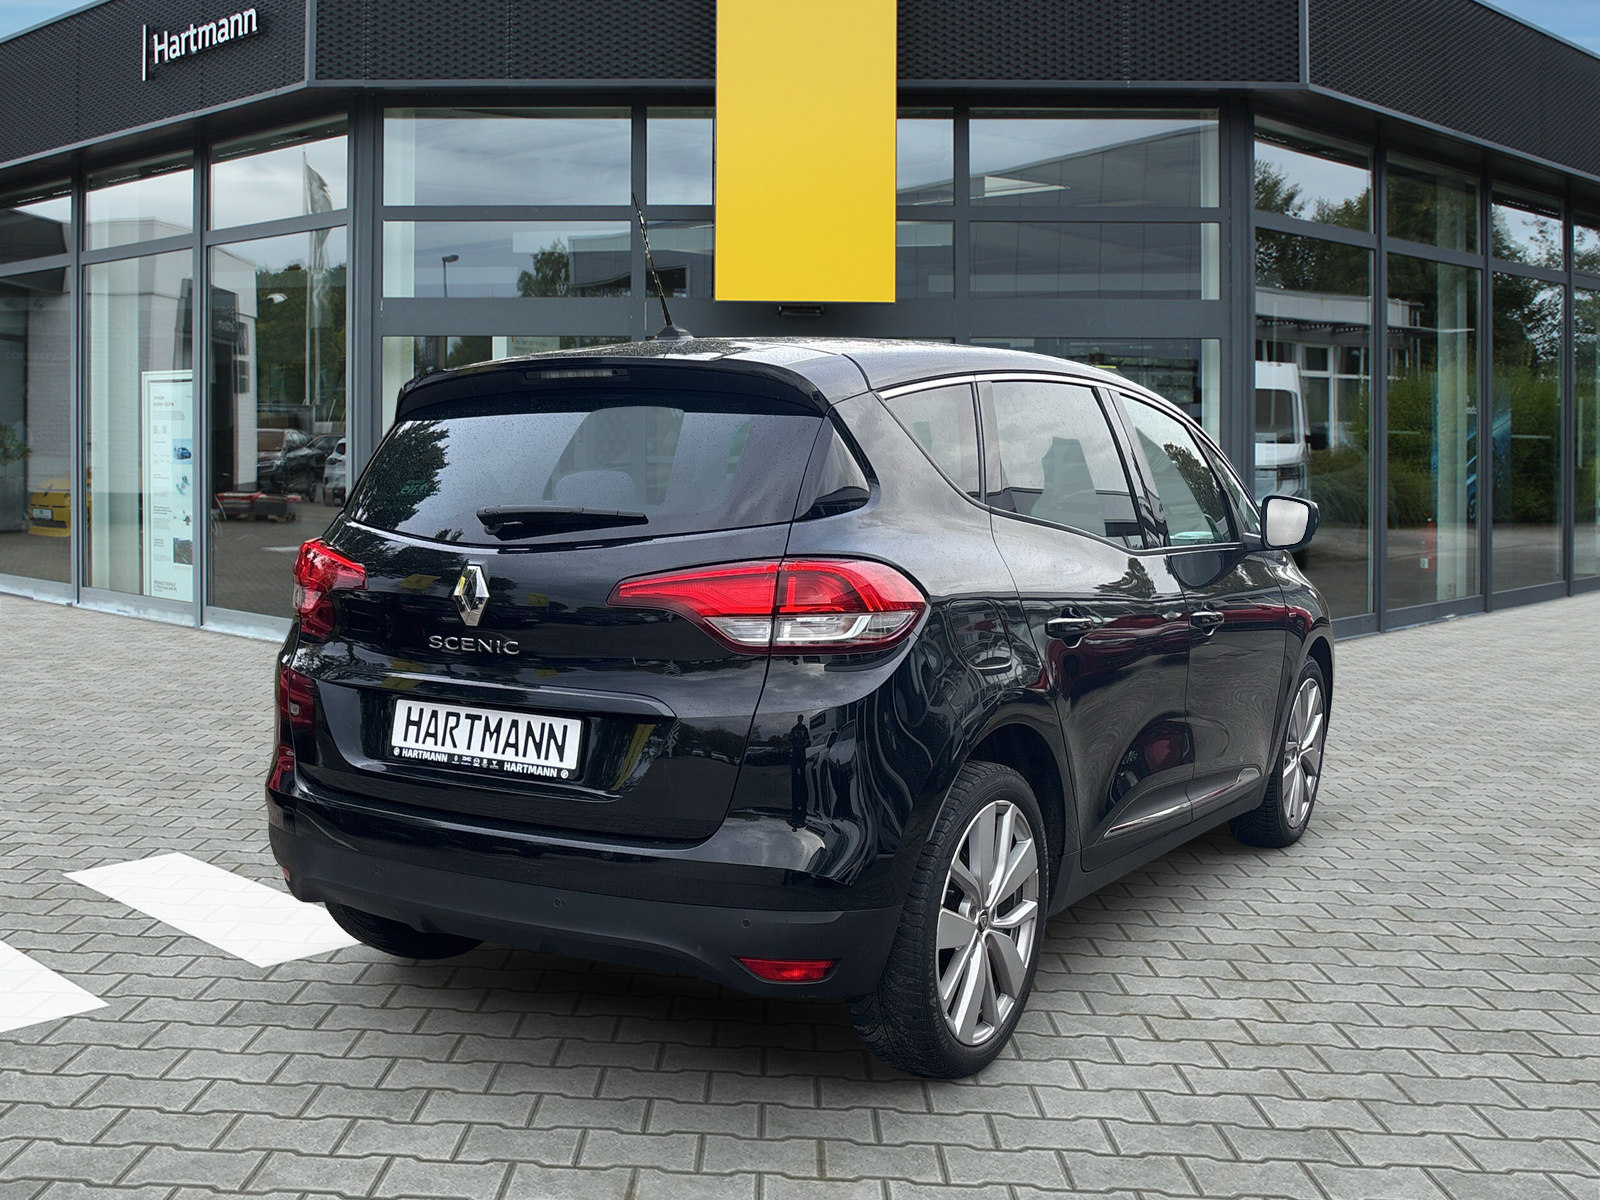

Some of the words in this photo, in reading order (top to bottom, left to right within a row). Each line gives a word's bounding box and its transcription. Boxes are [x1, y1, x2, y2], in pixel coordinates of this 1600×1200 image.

[152, 7, 258, 65] Hartmann
[429, 635, 520, 655] SCENIC
[403, 706, 568, 762] HARTMANN
[402, 748, 448, 762] HARTMANN
[504, 762, 557, 777] HARTMANN
